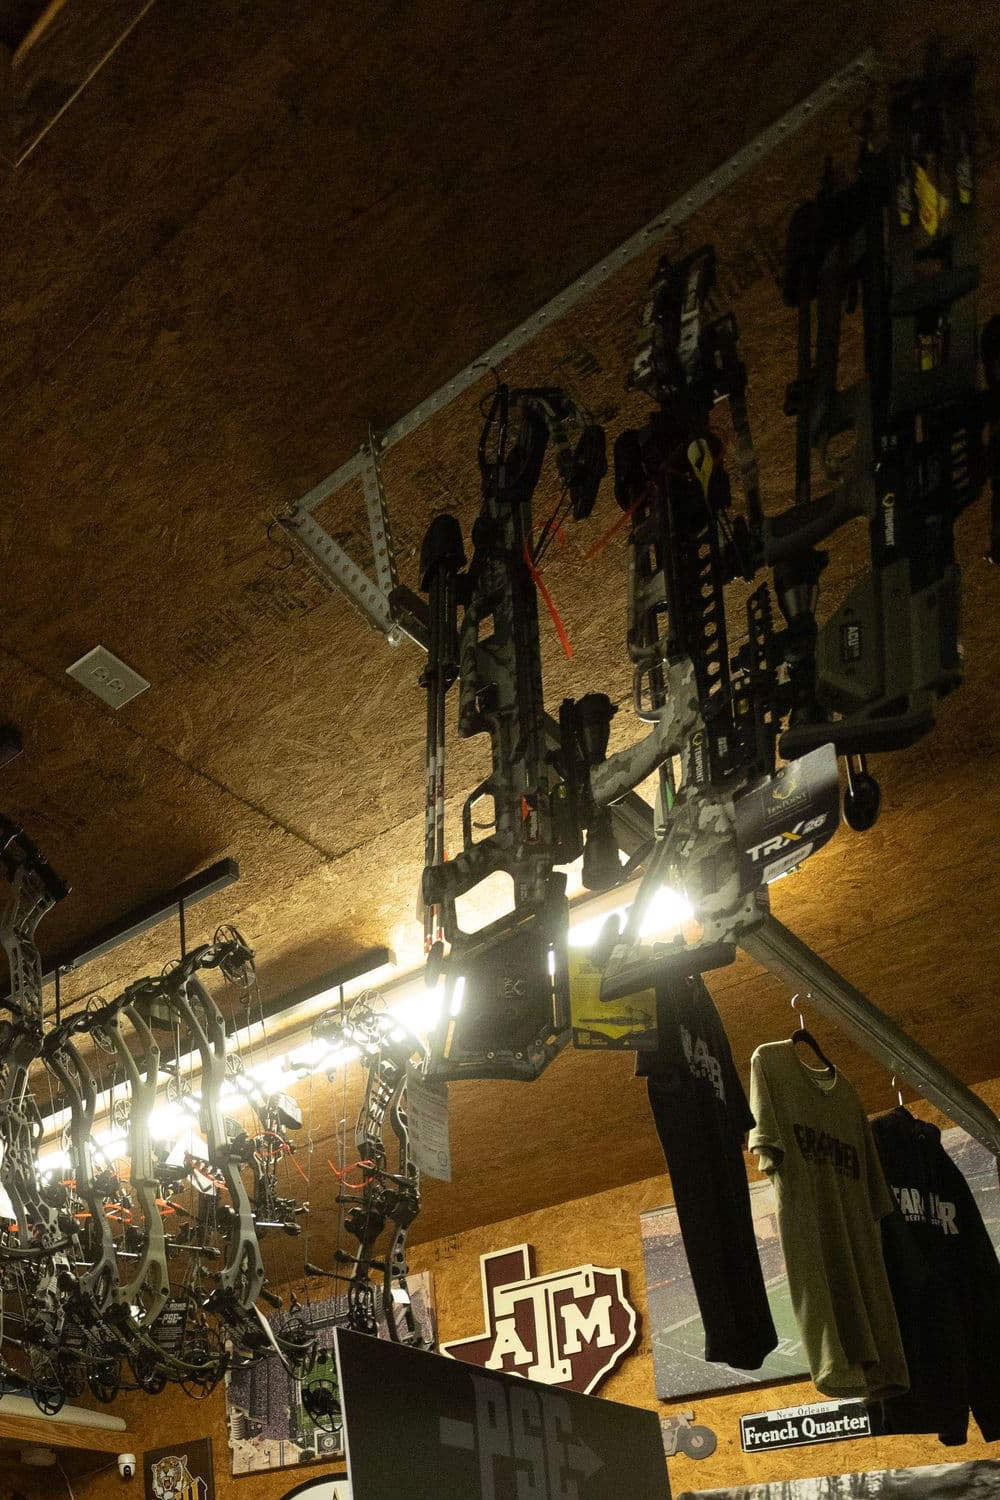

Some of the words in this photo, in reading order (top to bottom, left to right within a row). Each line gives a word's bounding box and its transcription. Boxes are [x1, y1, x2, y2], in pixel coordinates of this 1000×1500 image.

[745, 820, 805, 862] TRX
[776, 1410, 794, 1420] New
[797, 1405, 831, 1418] Orleans
[744, 1420, 799, 1446] French
[801, 1415, 868, 1438] Quarter
